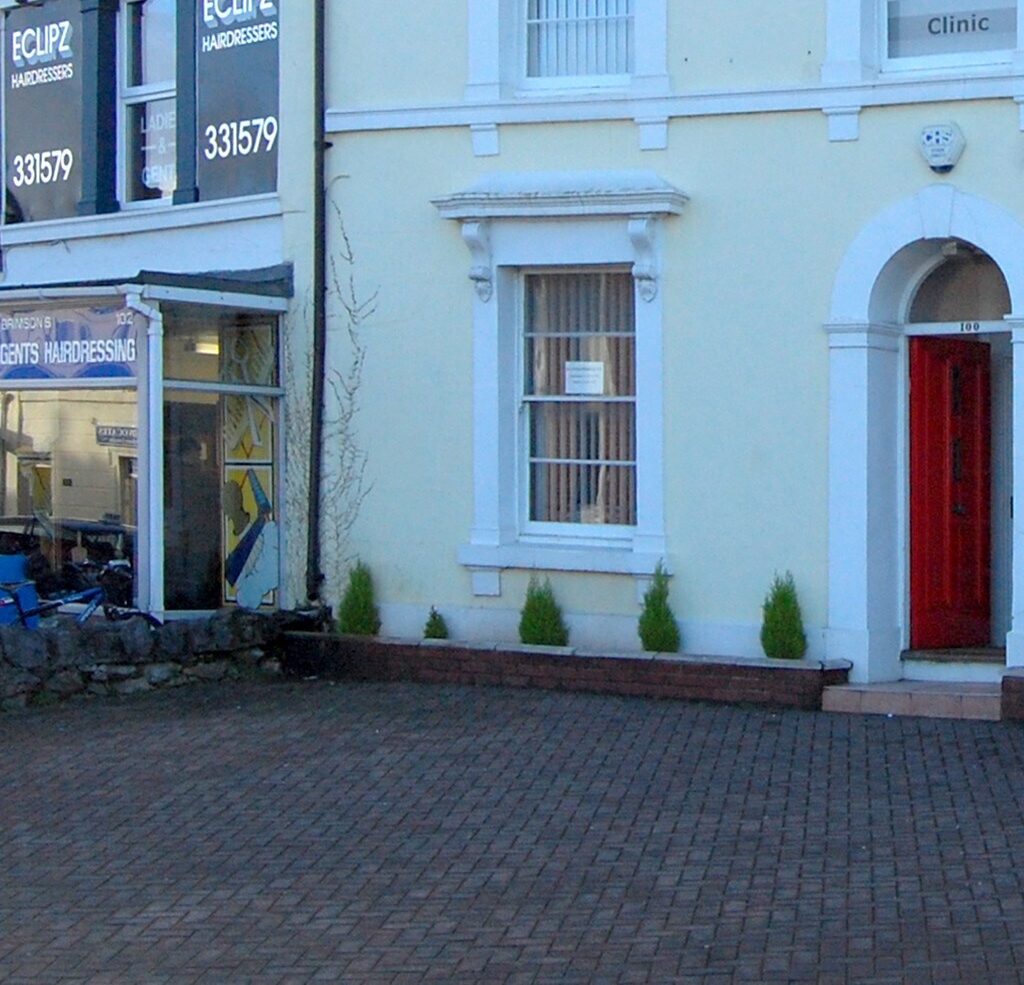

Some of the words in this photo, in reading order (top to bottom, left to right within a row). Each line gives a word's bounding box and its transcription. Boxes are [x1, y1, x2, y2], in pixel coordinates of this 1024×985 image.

[202, 21, 278, 52] HAIRDRESSERS
[927, 14, 990, 35] Clinic
[12, 20, 72, 63] ECLIPZ
[11, 62, 73, 89] HAIRDRESSERS
[140, 111, 176, 134] LADIE
[204, 116, 278, 160] 331579
[12, 148, 73, 187] 331579
[141, 164, 176, 187] GENT
[115, 312, 134, 326] 102
[960, 322, 980, 332] 100
[0, 342, 39, 365] GENTS
[44, 338, 136, 364] HAIRDRESSING
